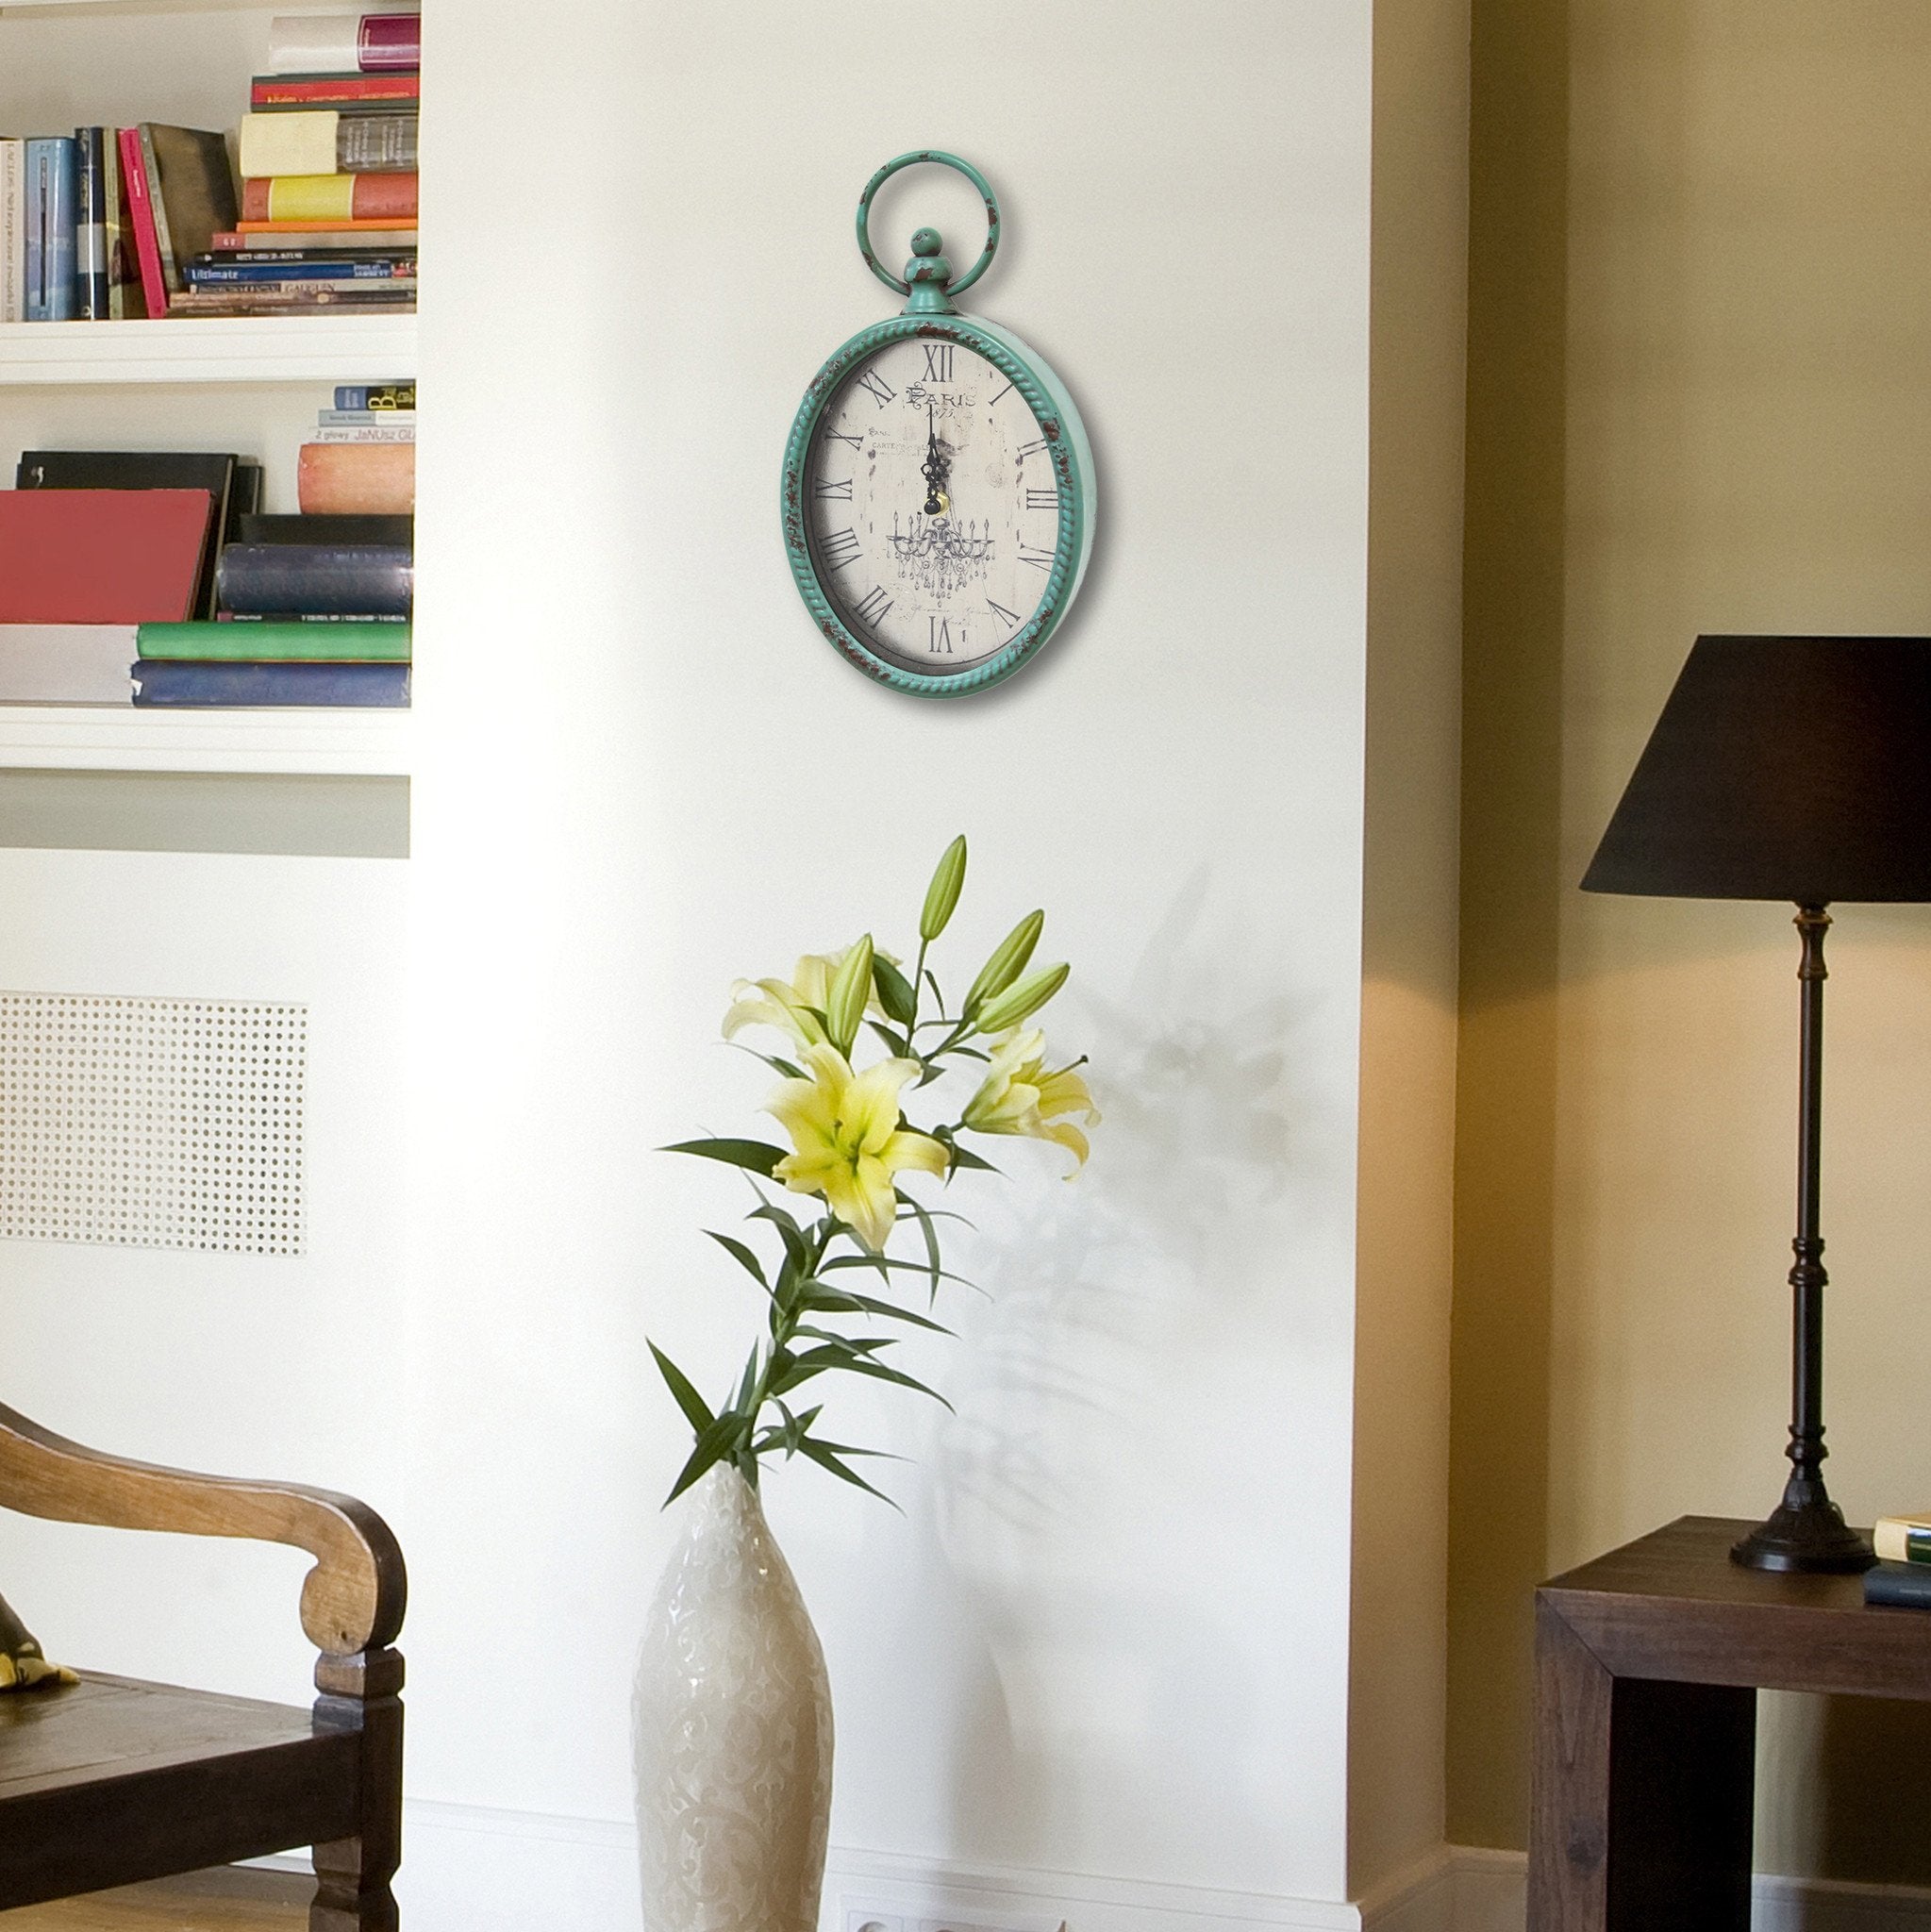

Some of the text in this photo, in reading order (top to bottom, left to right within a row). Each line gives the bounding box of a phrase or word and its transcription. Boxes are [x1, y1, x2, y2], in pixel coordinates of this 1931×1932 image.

[191, 268, 239, 280] Ultimate
[921, 344, 955, 382] XII
[906, 381, 976, 410] PARIS
